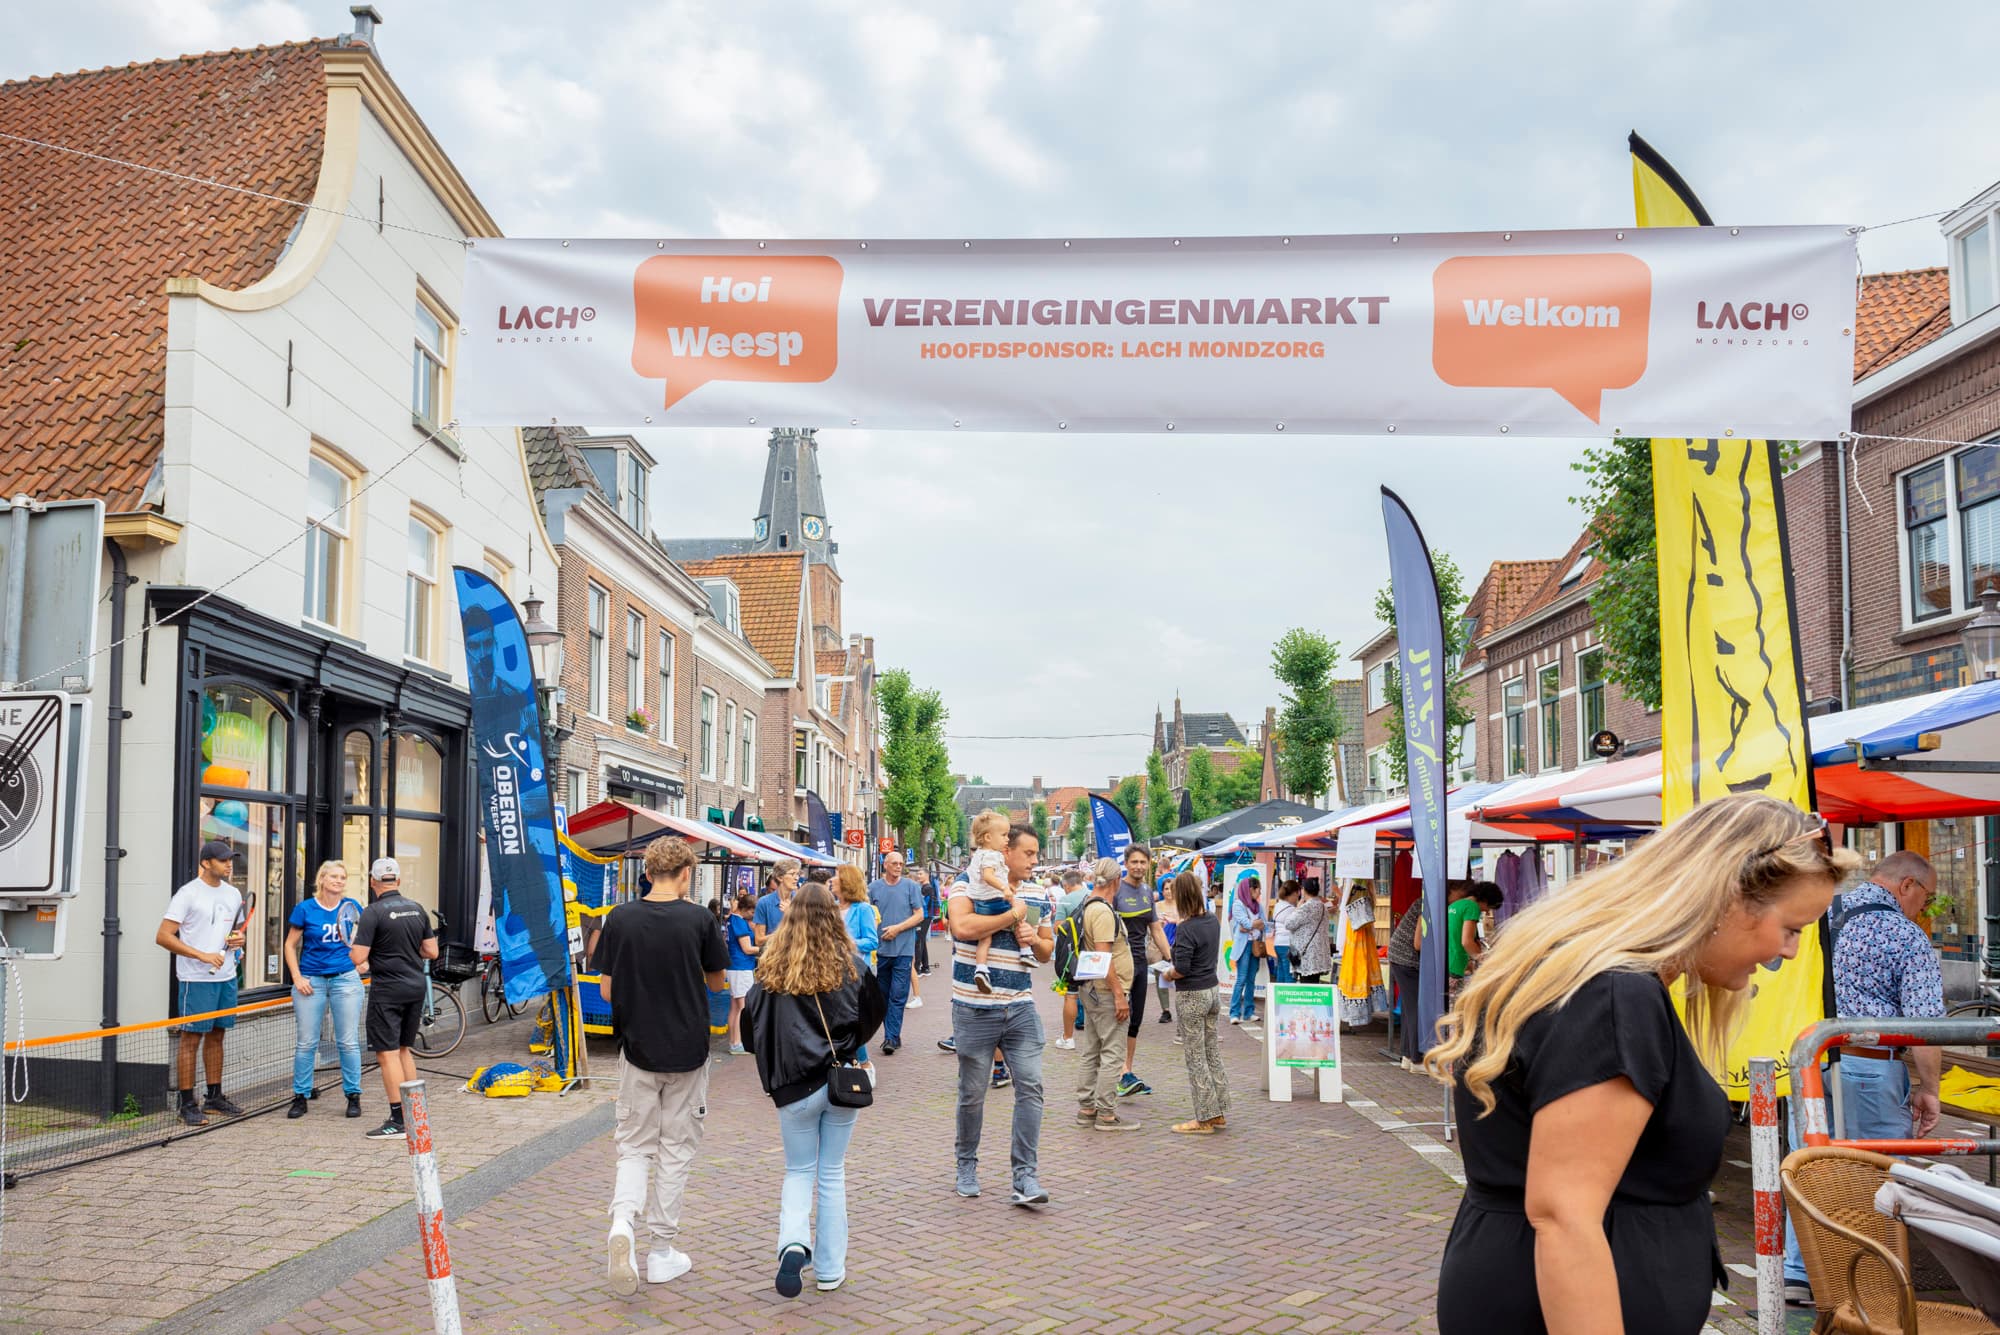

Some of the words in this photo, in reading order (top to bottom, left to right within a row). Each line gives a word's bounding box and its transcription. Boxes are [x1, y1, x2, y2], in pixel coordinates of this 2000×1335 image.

[700, 276, 773, 303] Hoi
[499, 305, 579, 331] LACH
[863, 296, 1390, 327] VERENIGINGENMARKT
[1463, 297, 1620, 328] Welkom
[1697, 300, 1789, 331] LACH
[497, 336, 593, 344] MONDZORG
[667, 326, 804, 366] Weesp
[920, 341, 1114, 359] HOOFDSPONSOR:
[1121, 341, 1181, 358] LACH
[1189, 341, 1325, 358] MONDZORG
[1696, 338, 1809, 346] MONDZORG
[490, 794, 500, 833] WEESP
[497, 766, 520, 855] OBERON
